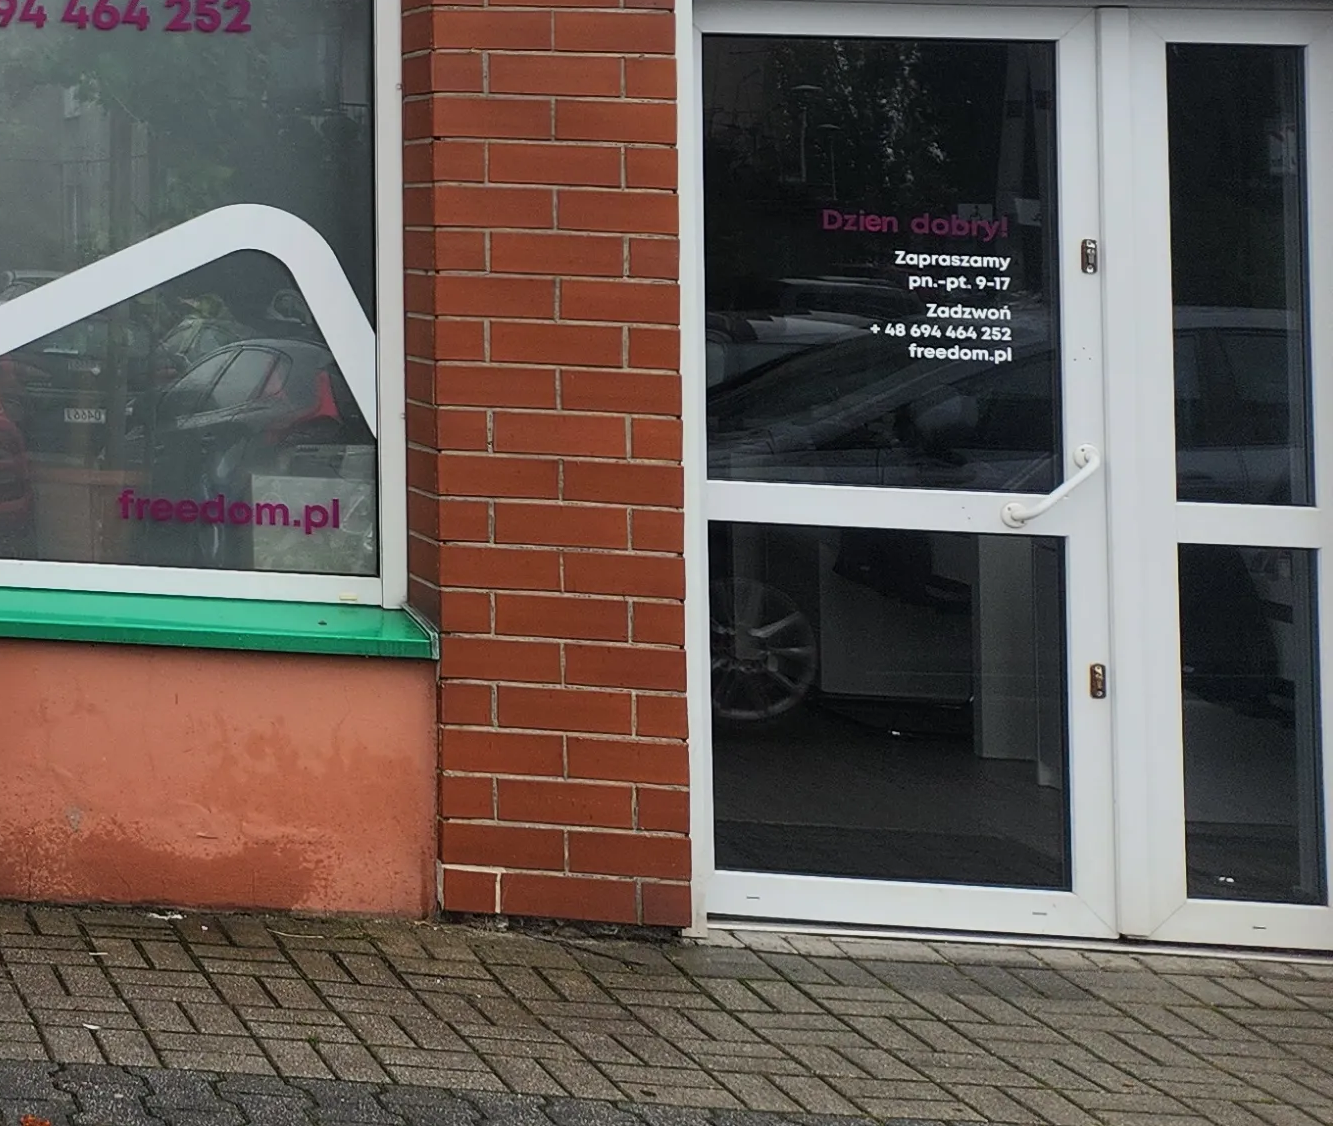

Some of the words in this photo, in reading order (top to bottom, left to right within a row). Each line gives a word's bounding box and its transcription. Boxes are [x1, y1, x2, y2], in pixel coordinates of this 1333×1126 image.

[910, 214, 1010, 242] dobry!
[893, 250, 1012, 272] Zapraszamy
[908, 273, 973, 292] pn.-pt.
[975, 275, 1012, 291] 9-17
[925, 302, 1012, 322] Zadzwoń
[884, 321, 906, 338] 48
[909, 322, 942, 340] 694
[945, 324, 978, 341] 464
[980, 325, 1013, 343] 252
[907, 343, 1013, 364] freedom.pl
[118, 488, 341, 535] freedom.pl
